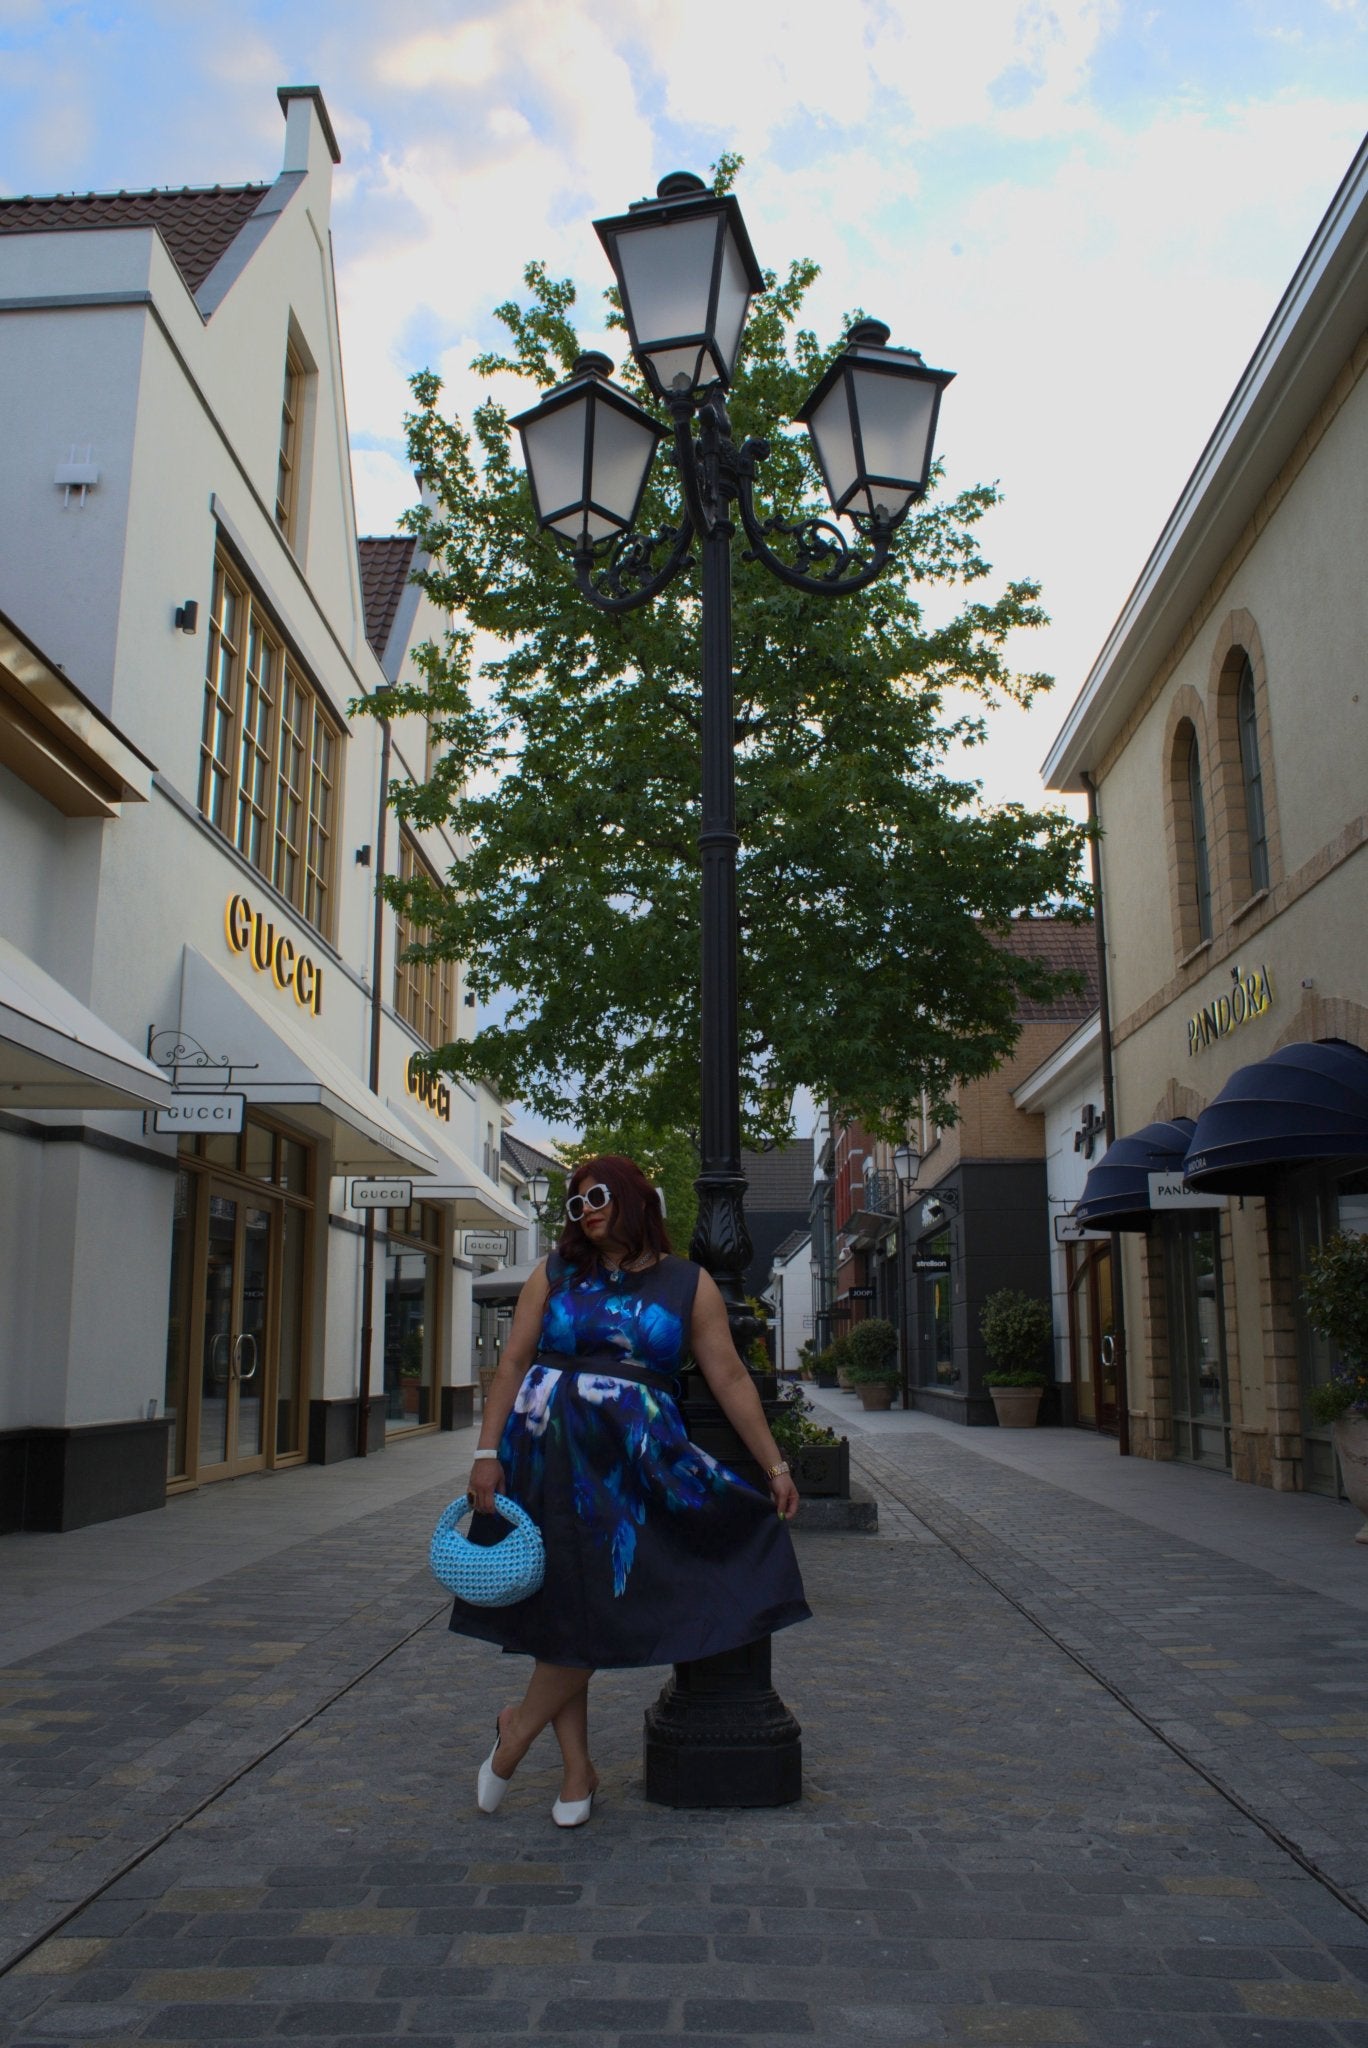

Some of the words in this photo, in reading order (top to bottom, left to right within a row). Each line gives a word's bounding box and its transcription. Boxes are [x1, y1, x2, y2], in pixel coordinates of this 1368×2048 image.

[227, 894, 322, 1016] GUCCI
[1188, 965, 1273, 1057] PANDORA
[167, 1107, 232, 1120] GUCCI
[360, 1189, 404, 1200] GUCCI
[470, 1242, 502, 1251] GUCCI
